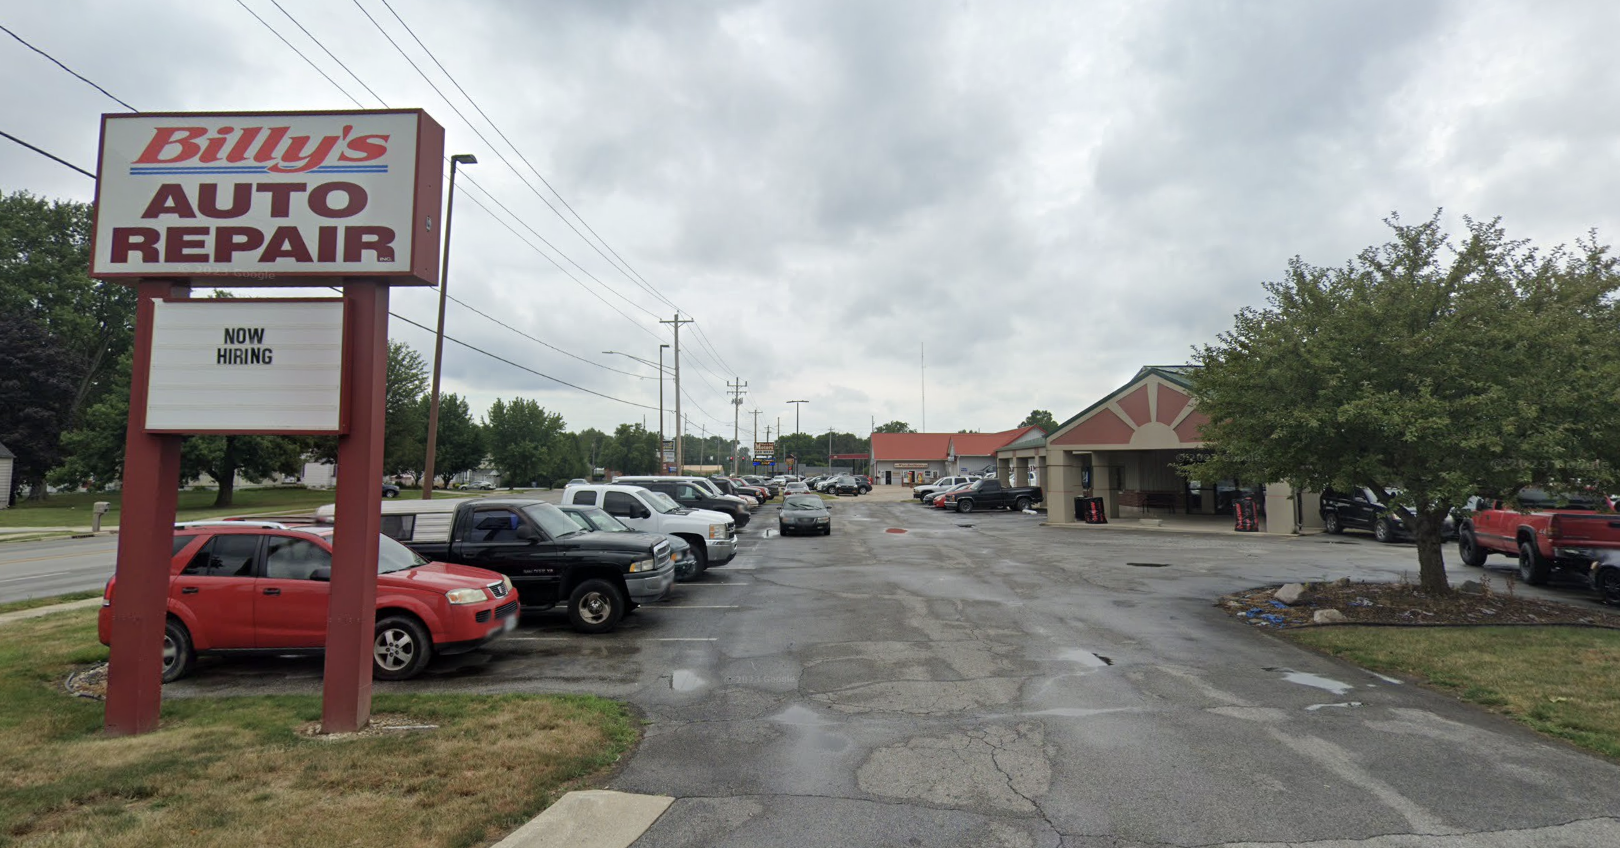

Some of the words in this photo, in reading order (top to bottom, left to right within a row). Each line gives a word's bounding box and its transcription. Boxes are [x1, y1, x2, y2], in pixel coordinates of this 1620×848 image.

[131, 124, 391, 174] Billy's
[141, 182, 369, 219] AUTO
[110, 225, 396, 264] REPAIR
[224, 327, 266, 345] NOW
[216, 347, 274, 366] HIRING
